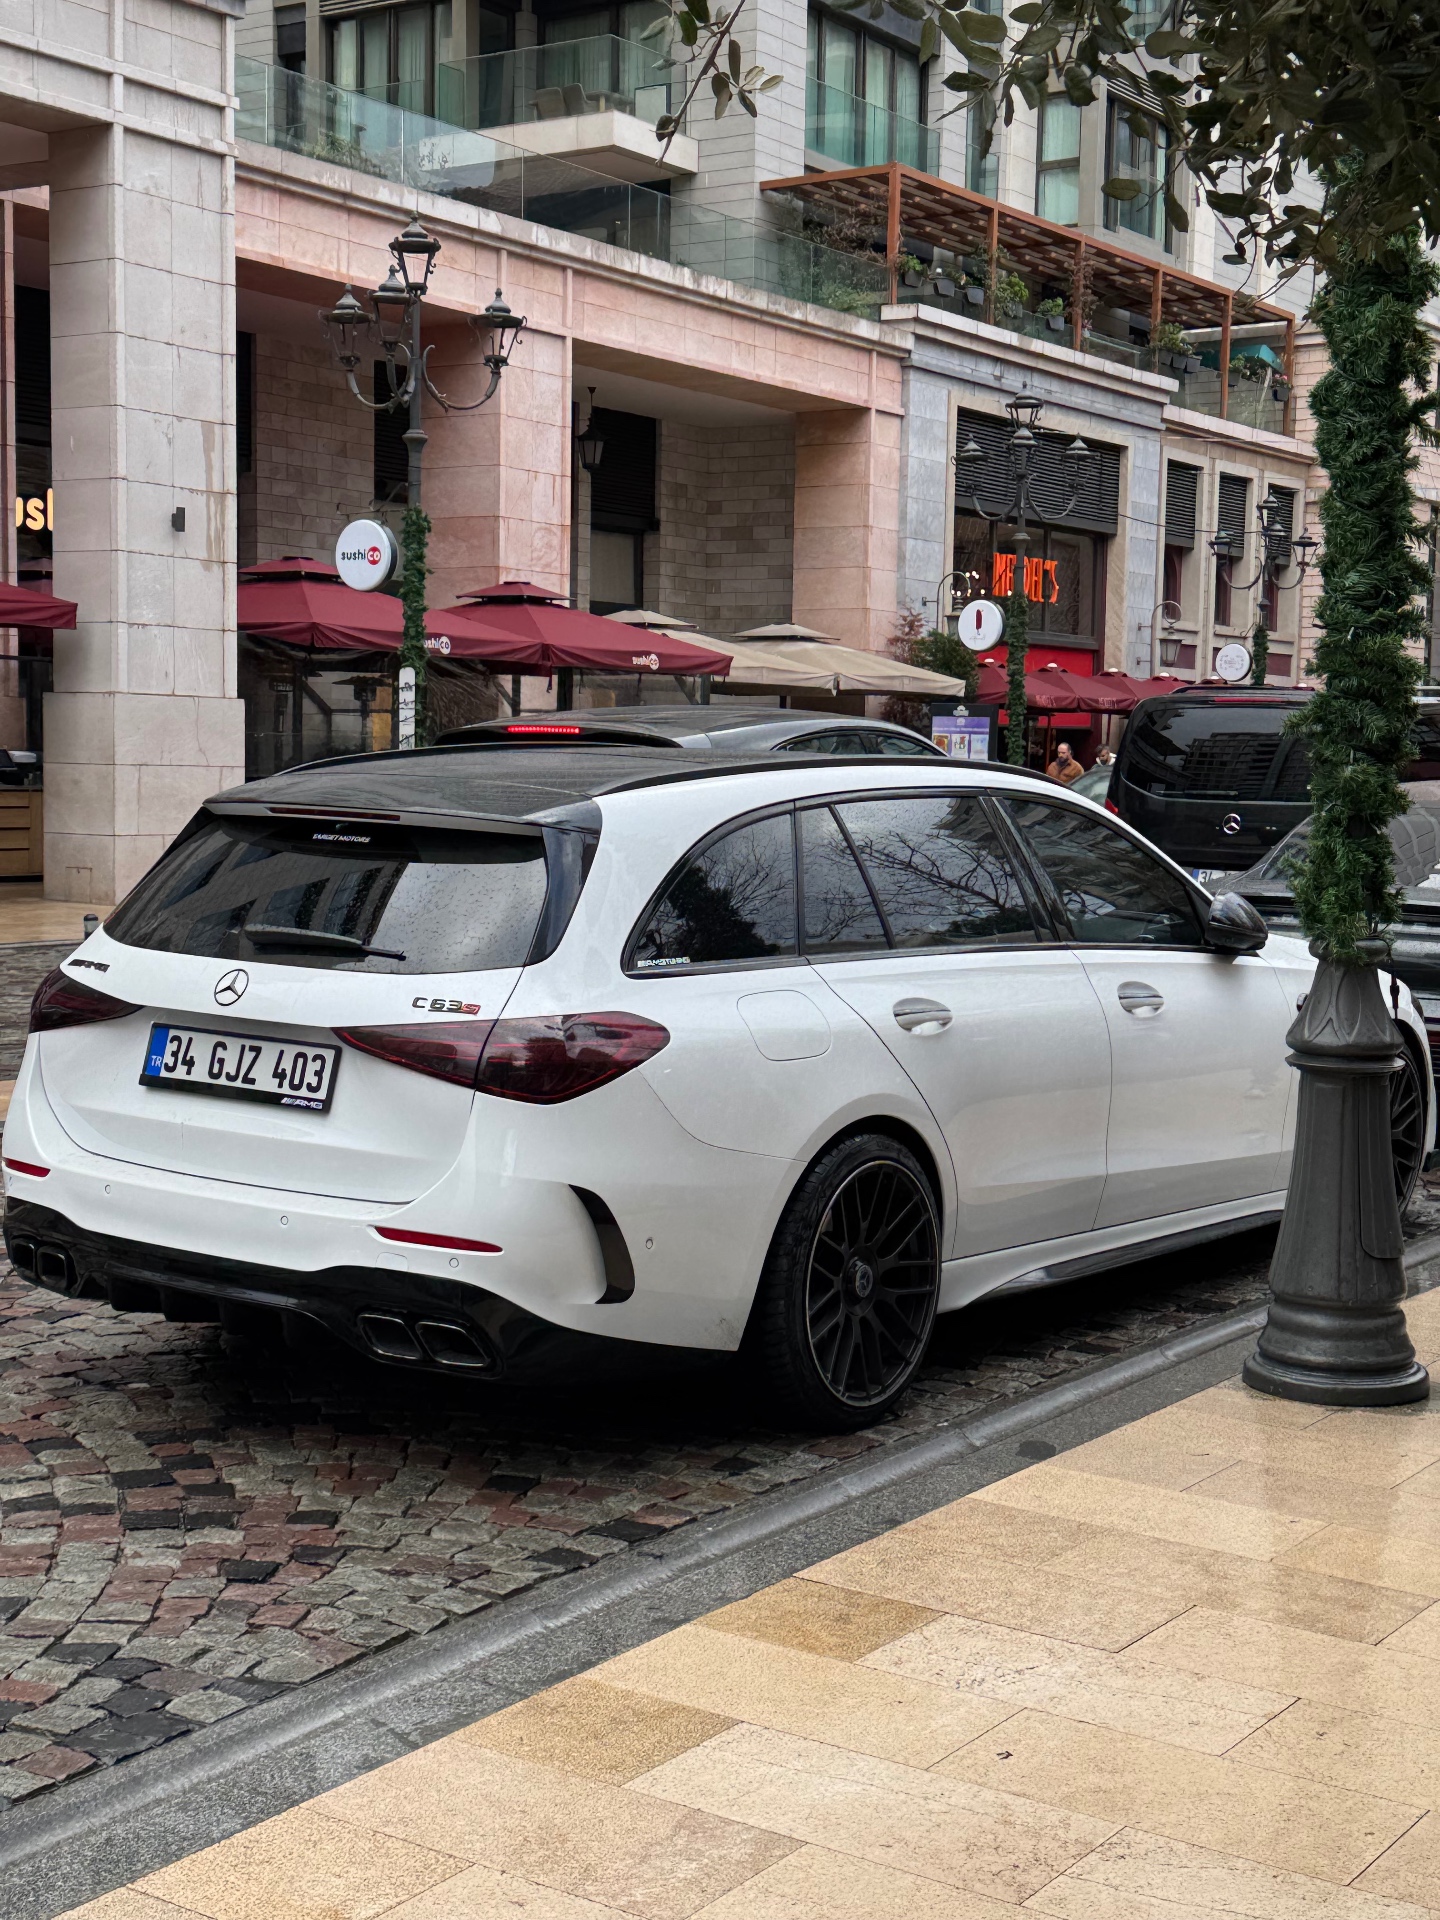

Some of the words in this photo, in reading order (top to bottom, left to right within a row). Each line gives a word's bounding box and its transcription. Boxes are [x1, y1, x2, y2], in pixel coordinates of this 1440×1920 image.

[992, 552, 1059, 604] MEDEL'S
[423, 636, 451, 652] ushico
[151, 1055, 163, 1068] TR
[163, 1034, 196, 1076] 34
[207, 1041, 263, 1086] GJZ
[271, 1049, 327, 1094] 403
[292, 1098, 323, 1109] AMG
